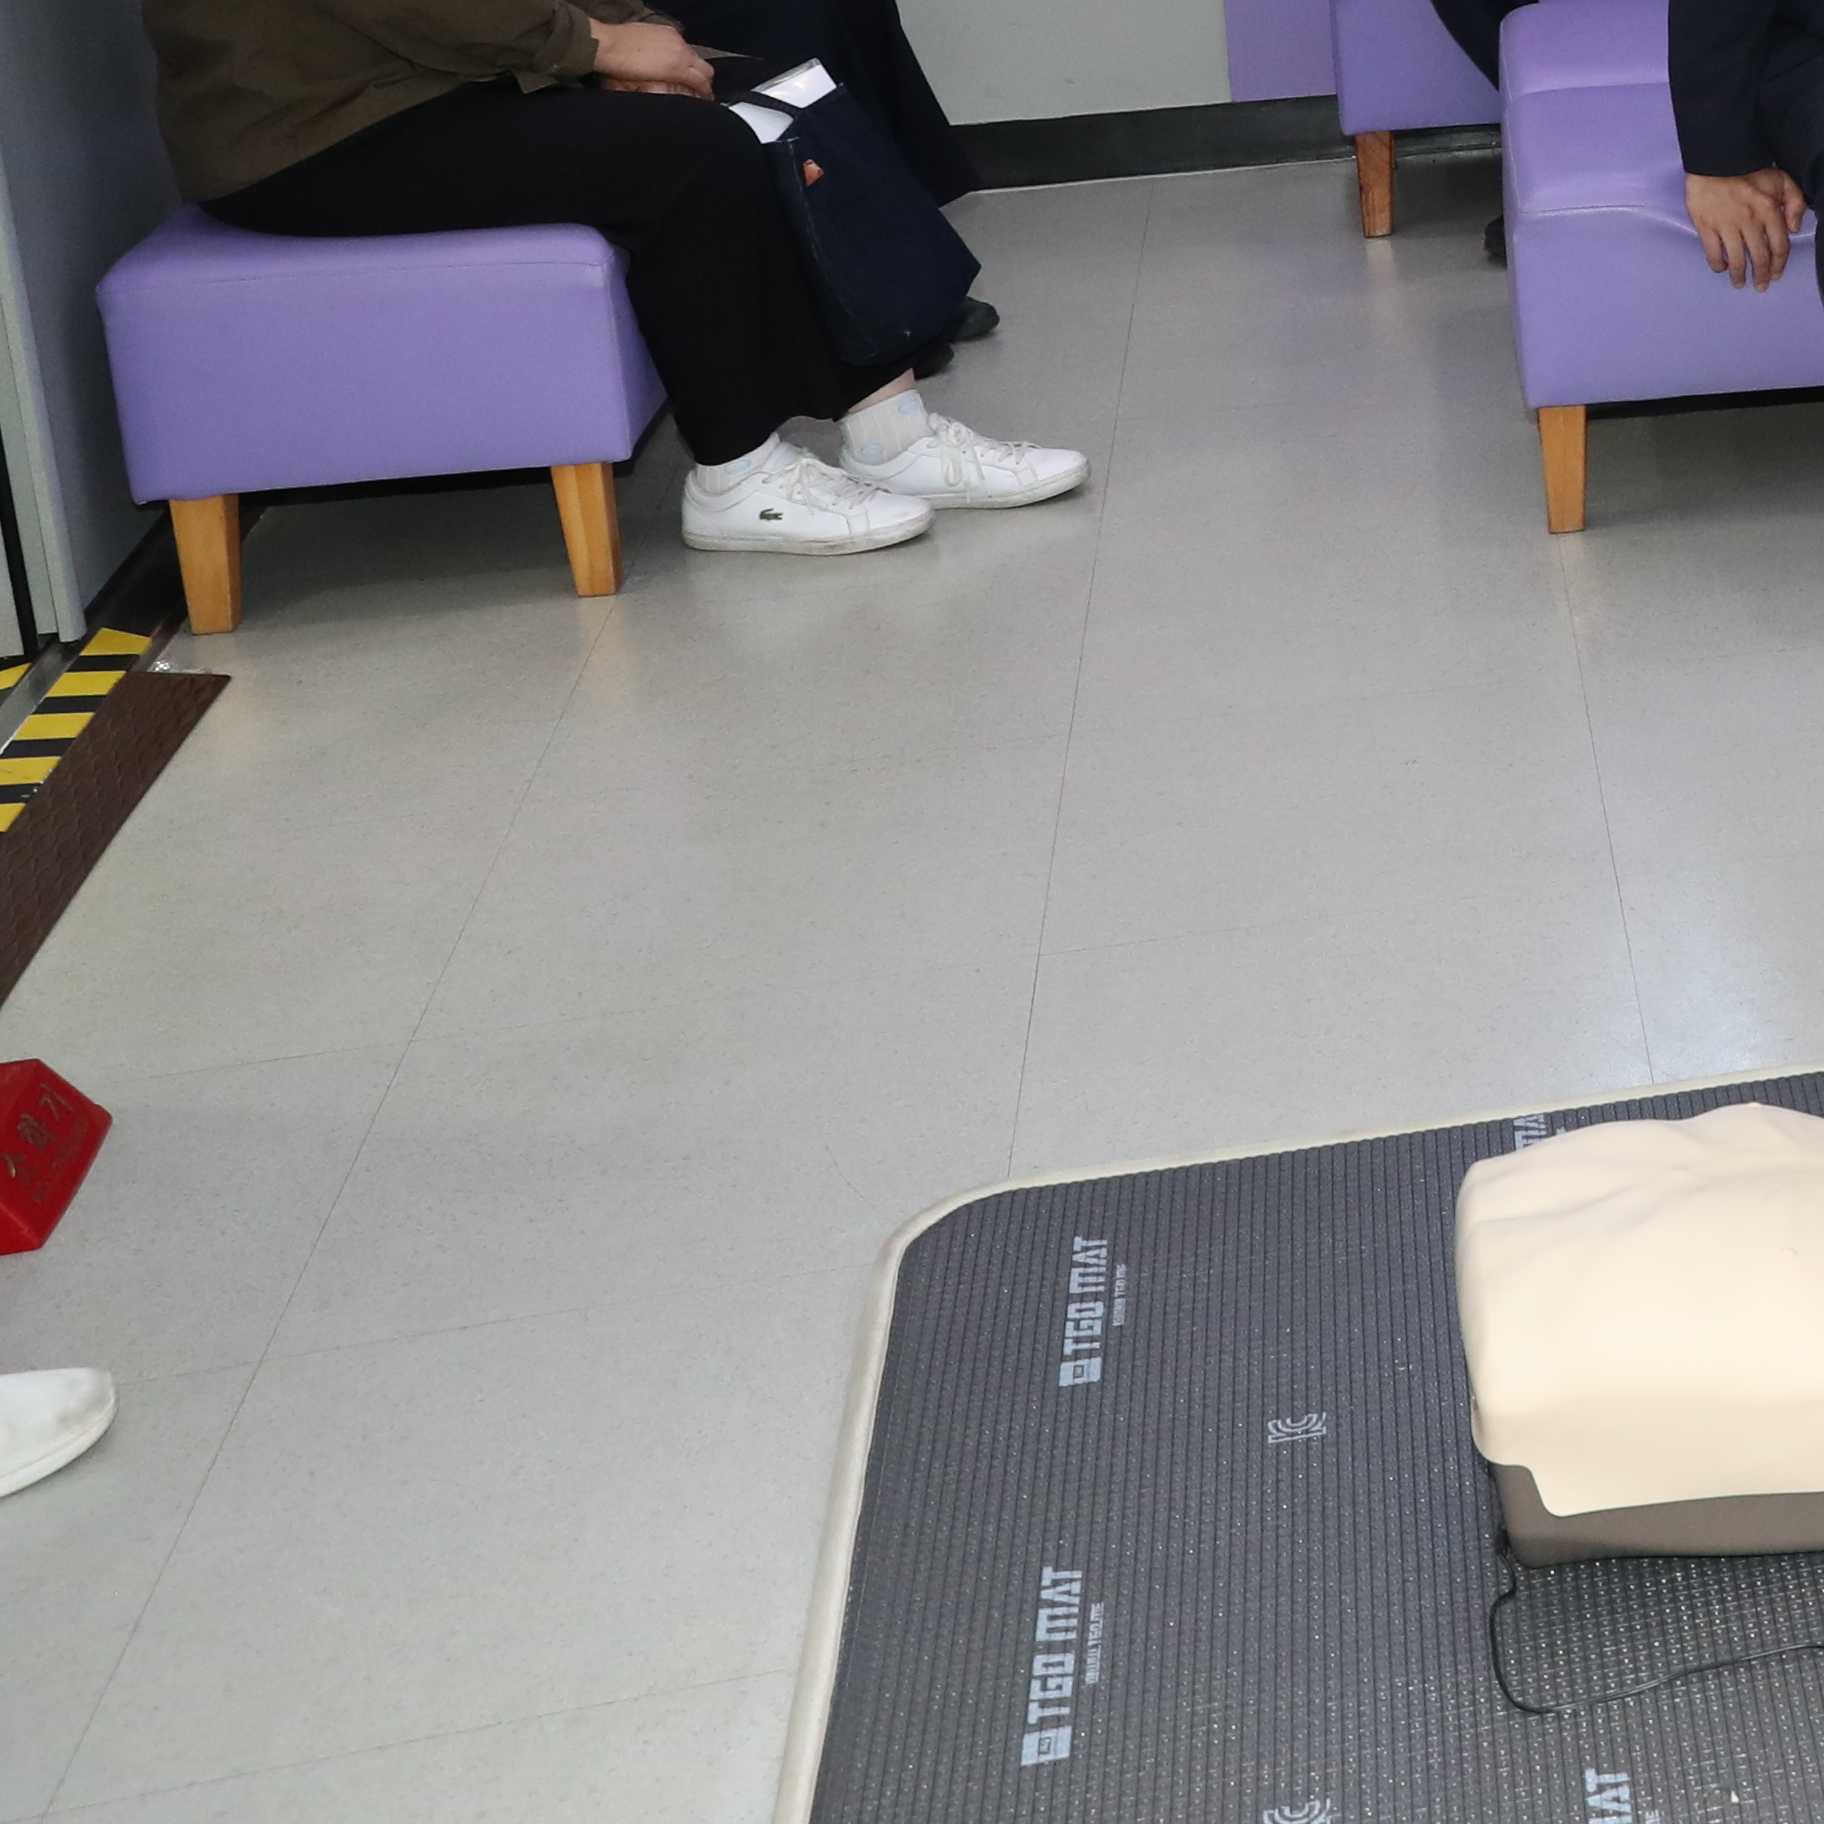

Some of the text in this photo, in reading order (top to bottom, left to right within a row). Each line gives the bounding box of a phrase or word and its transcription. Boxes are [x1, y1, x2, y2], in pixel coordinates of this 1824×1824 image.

[1063, 1236, 1107, 1355] TGO MAT
[1027, 1566, 1082, 1724] TGO MAT
